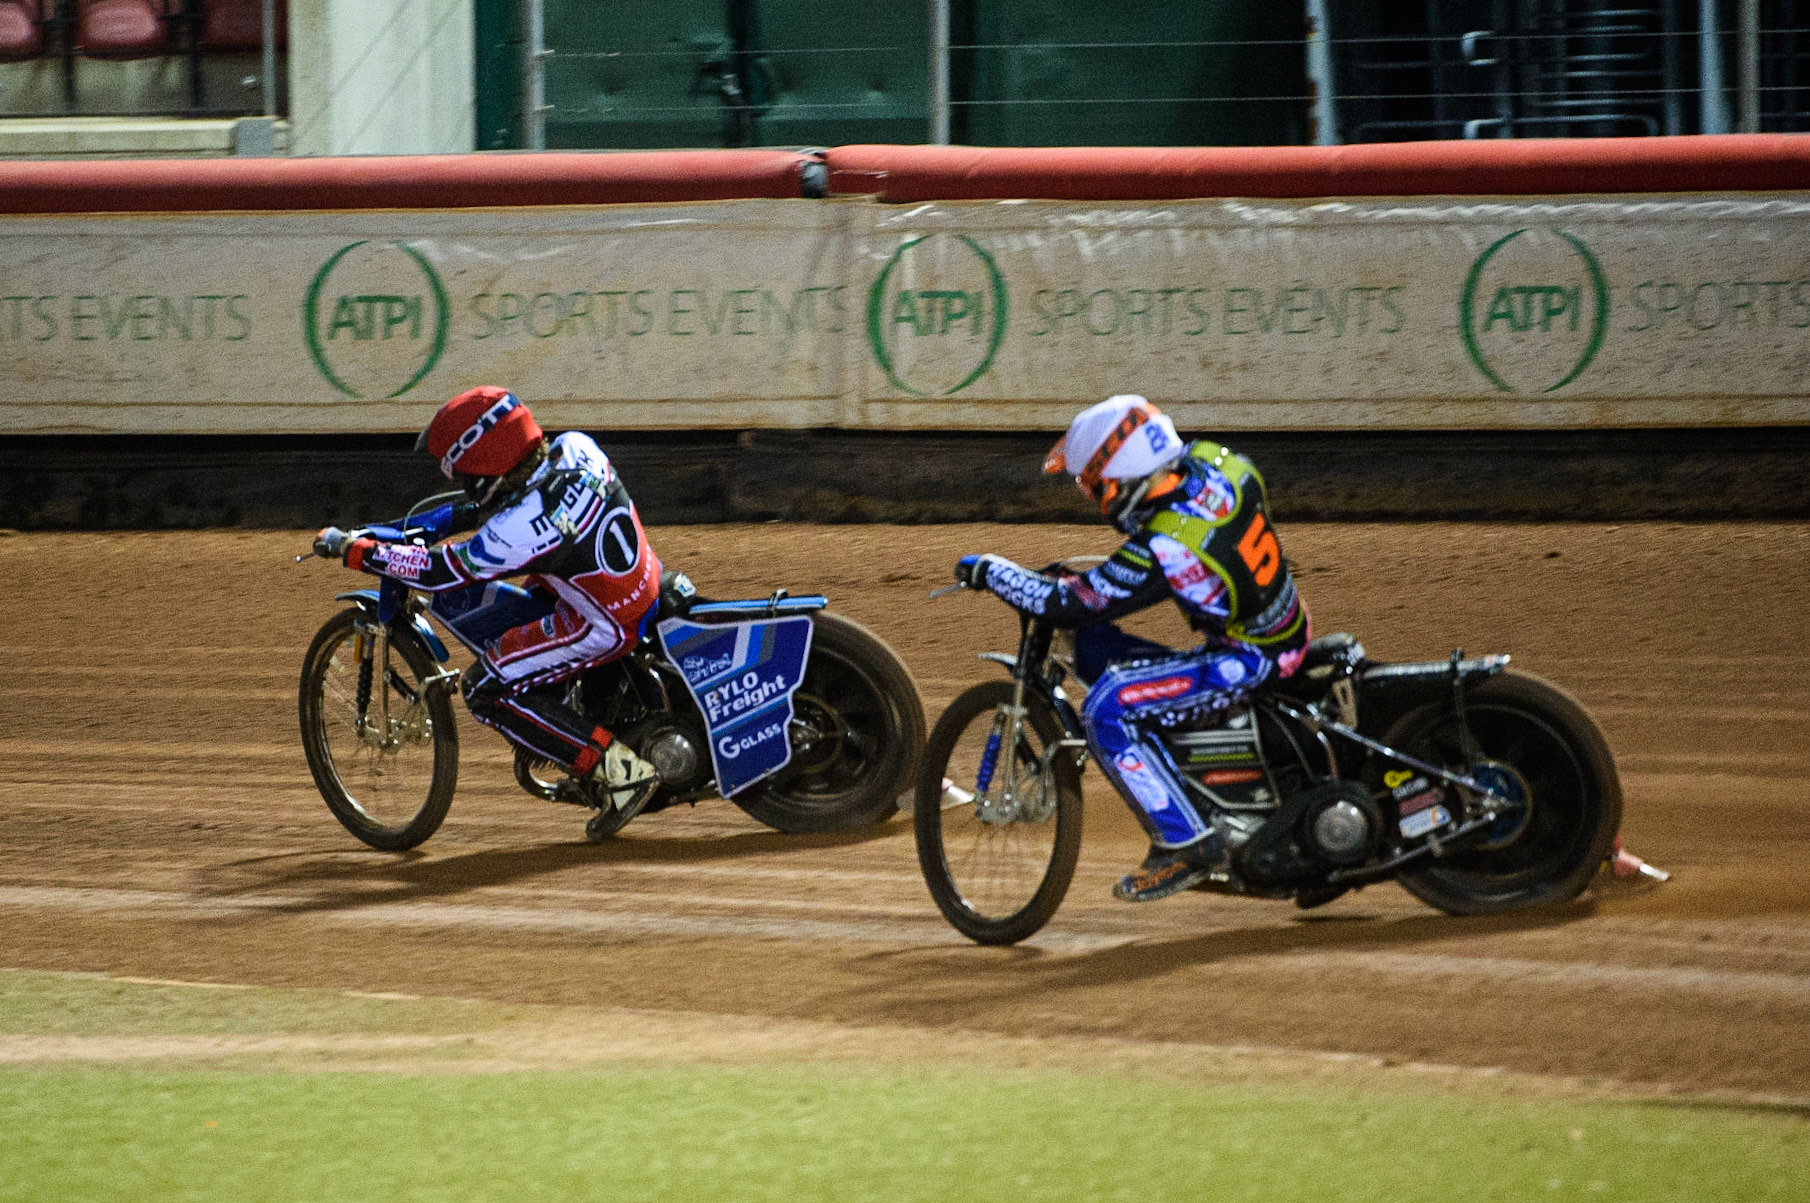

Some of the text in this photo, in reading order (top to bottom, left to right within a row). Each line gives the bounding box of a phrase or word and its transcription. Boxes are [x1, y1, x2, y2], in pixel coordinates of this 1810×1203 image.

[70, 294, 252, 342] EVENTS
[327, 294, 422, 341] ATPI
[468, 285, 848, 338] SPORTS EVENTS
[892, 289, 985, 336] ATPI
[1028, 285, 1406, 337] SPORTS EVENTS
[1482, 284, 1581, 332] ATPI
[608, 519, 635, 567] 1
[1237, 512, 1279, 587] 5
[704, 671, 760, 709] RYLO
[707, 673, 786, 723] Freight
[718, 723, 782, 759] G GLASS
